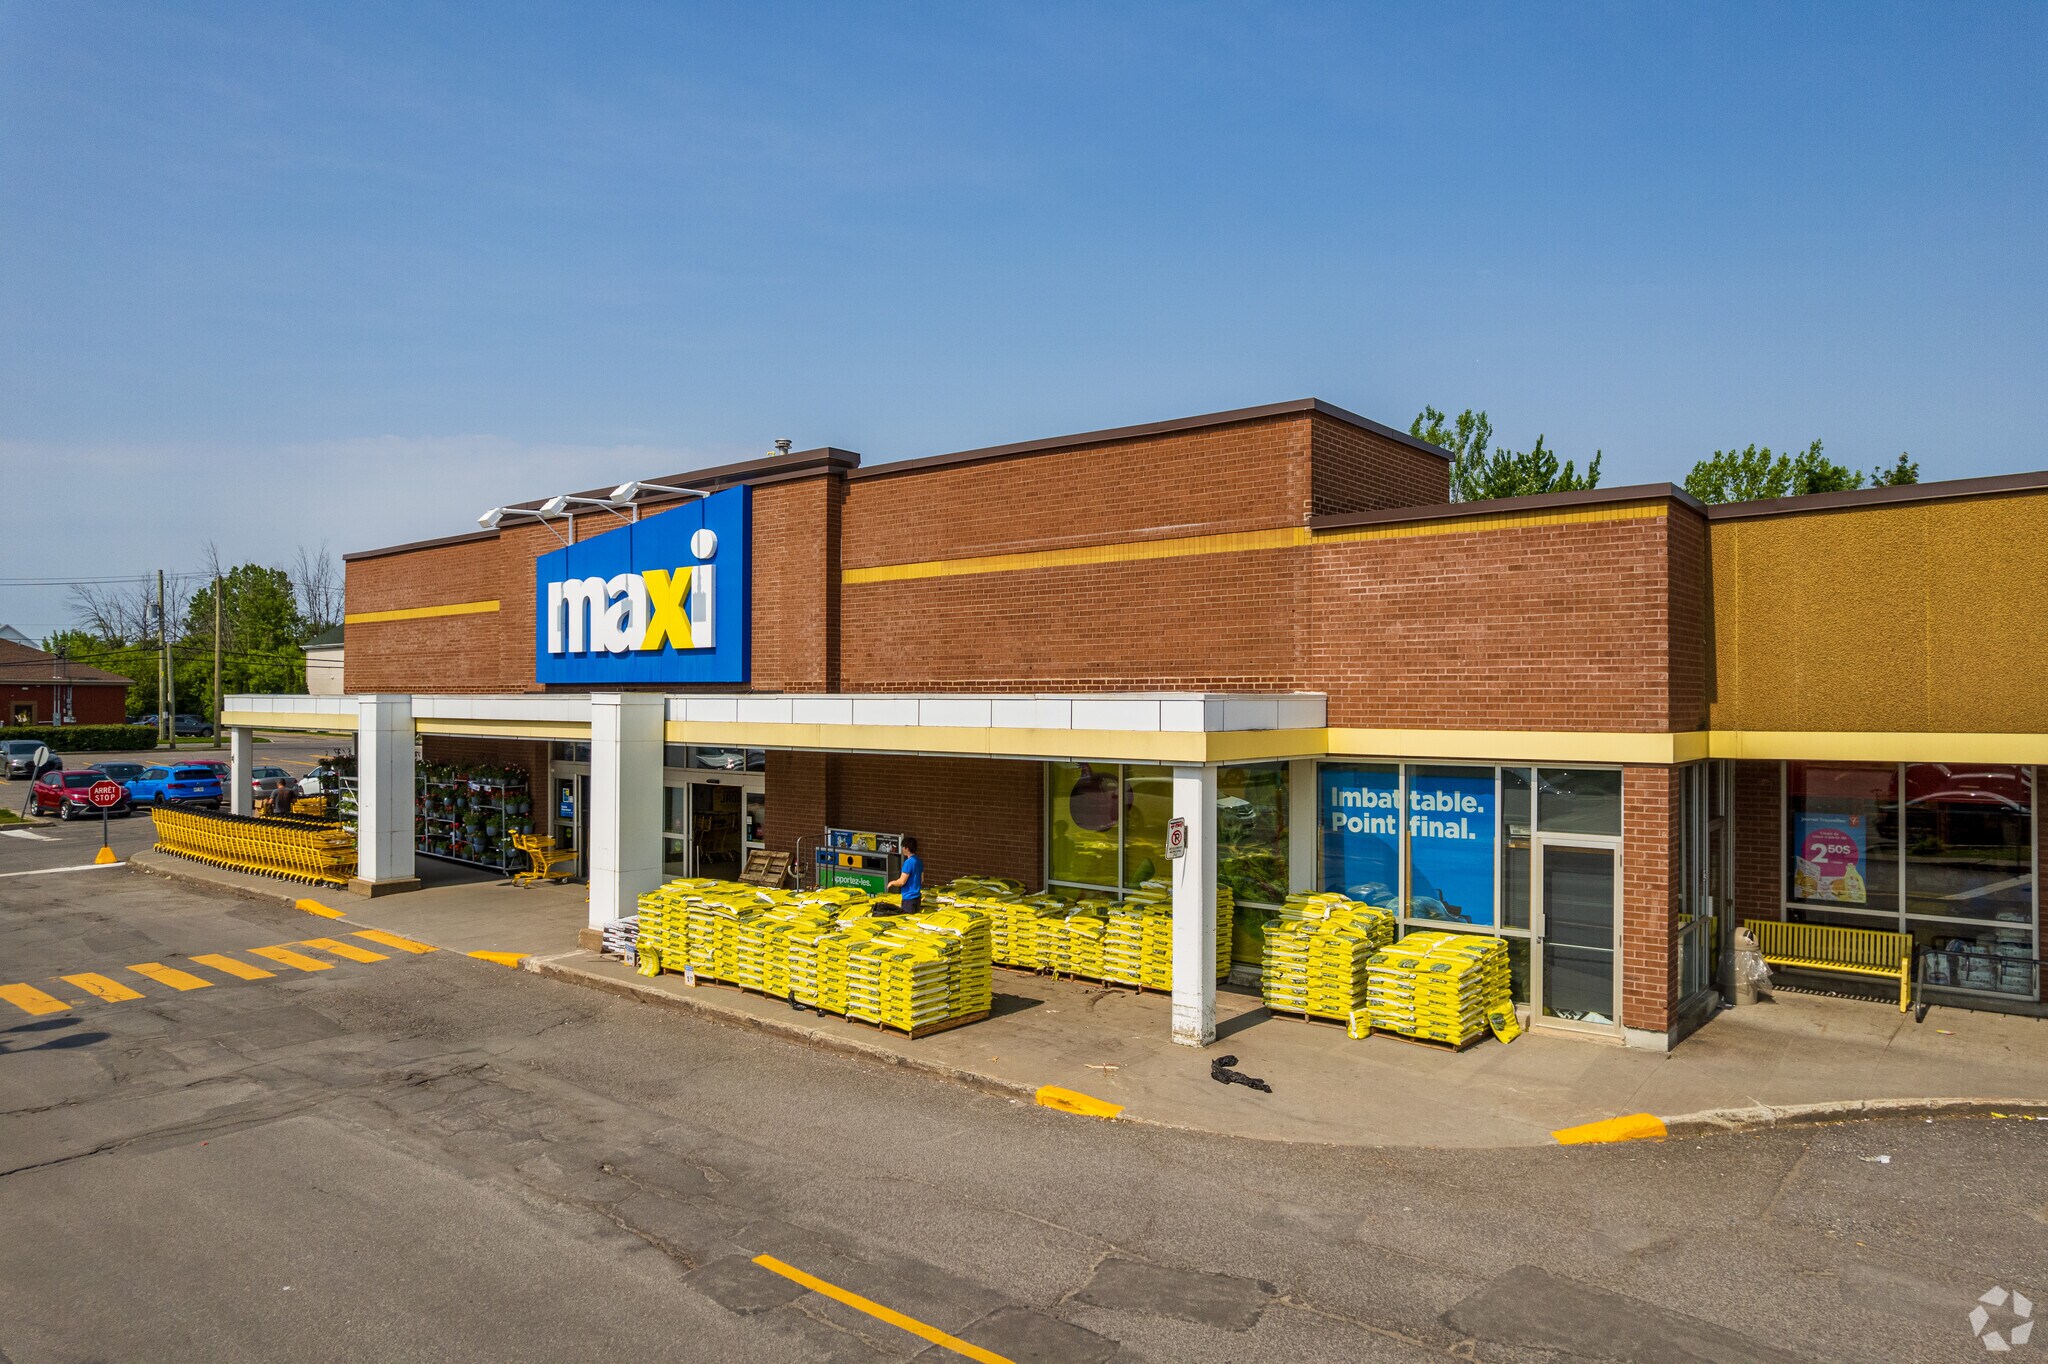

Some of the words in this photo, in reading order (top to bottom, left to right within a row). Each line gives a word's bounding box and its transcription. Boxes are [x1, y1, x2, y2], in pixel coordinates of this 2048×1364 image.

[548, 528, 718, 654] maxi
[94, 786, 116, 794] ARRÊT
[1332, 812, 1396, 835] Point
[1409, 815, 1476, 839] final.
